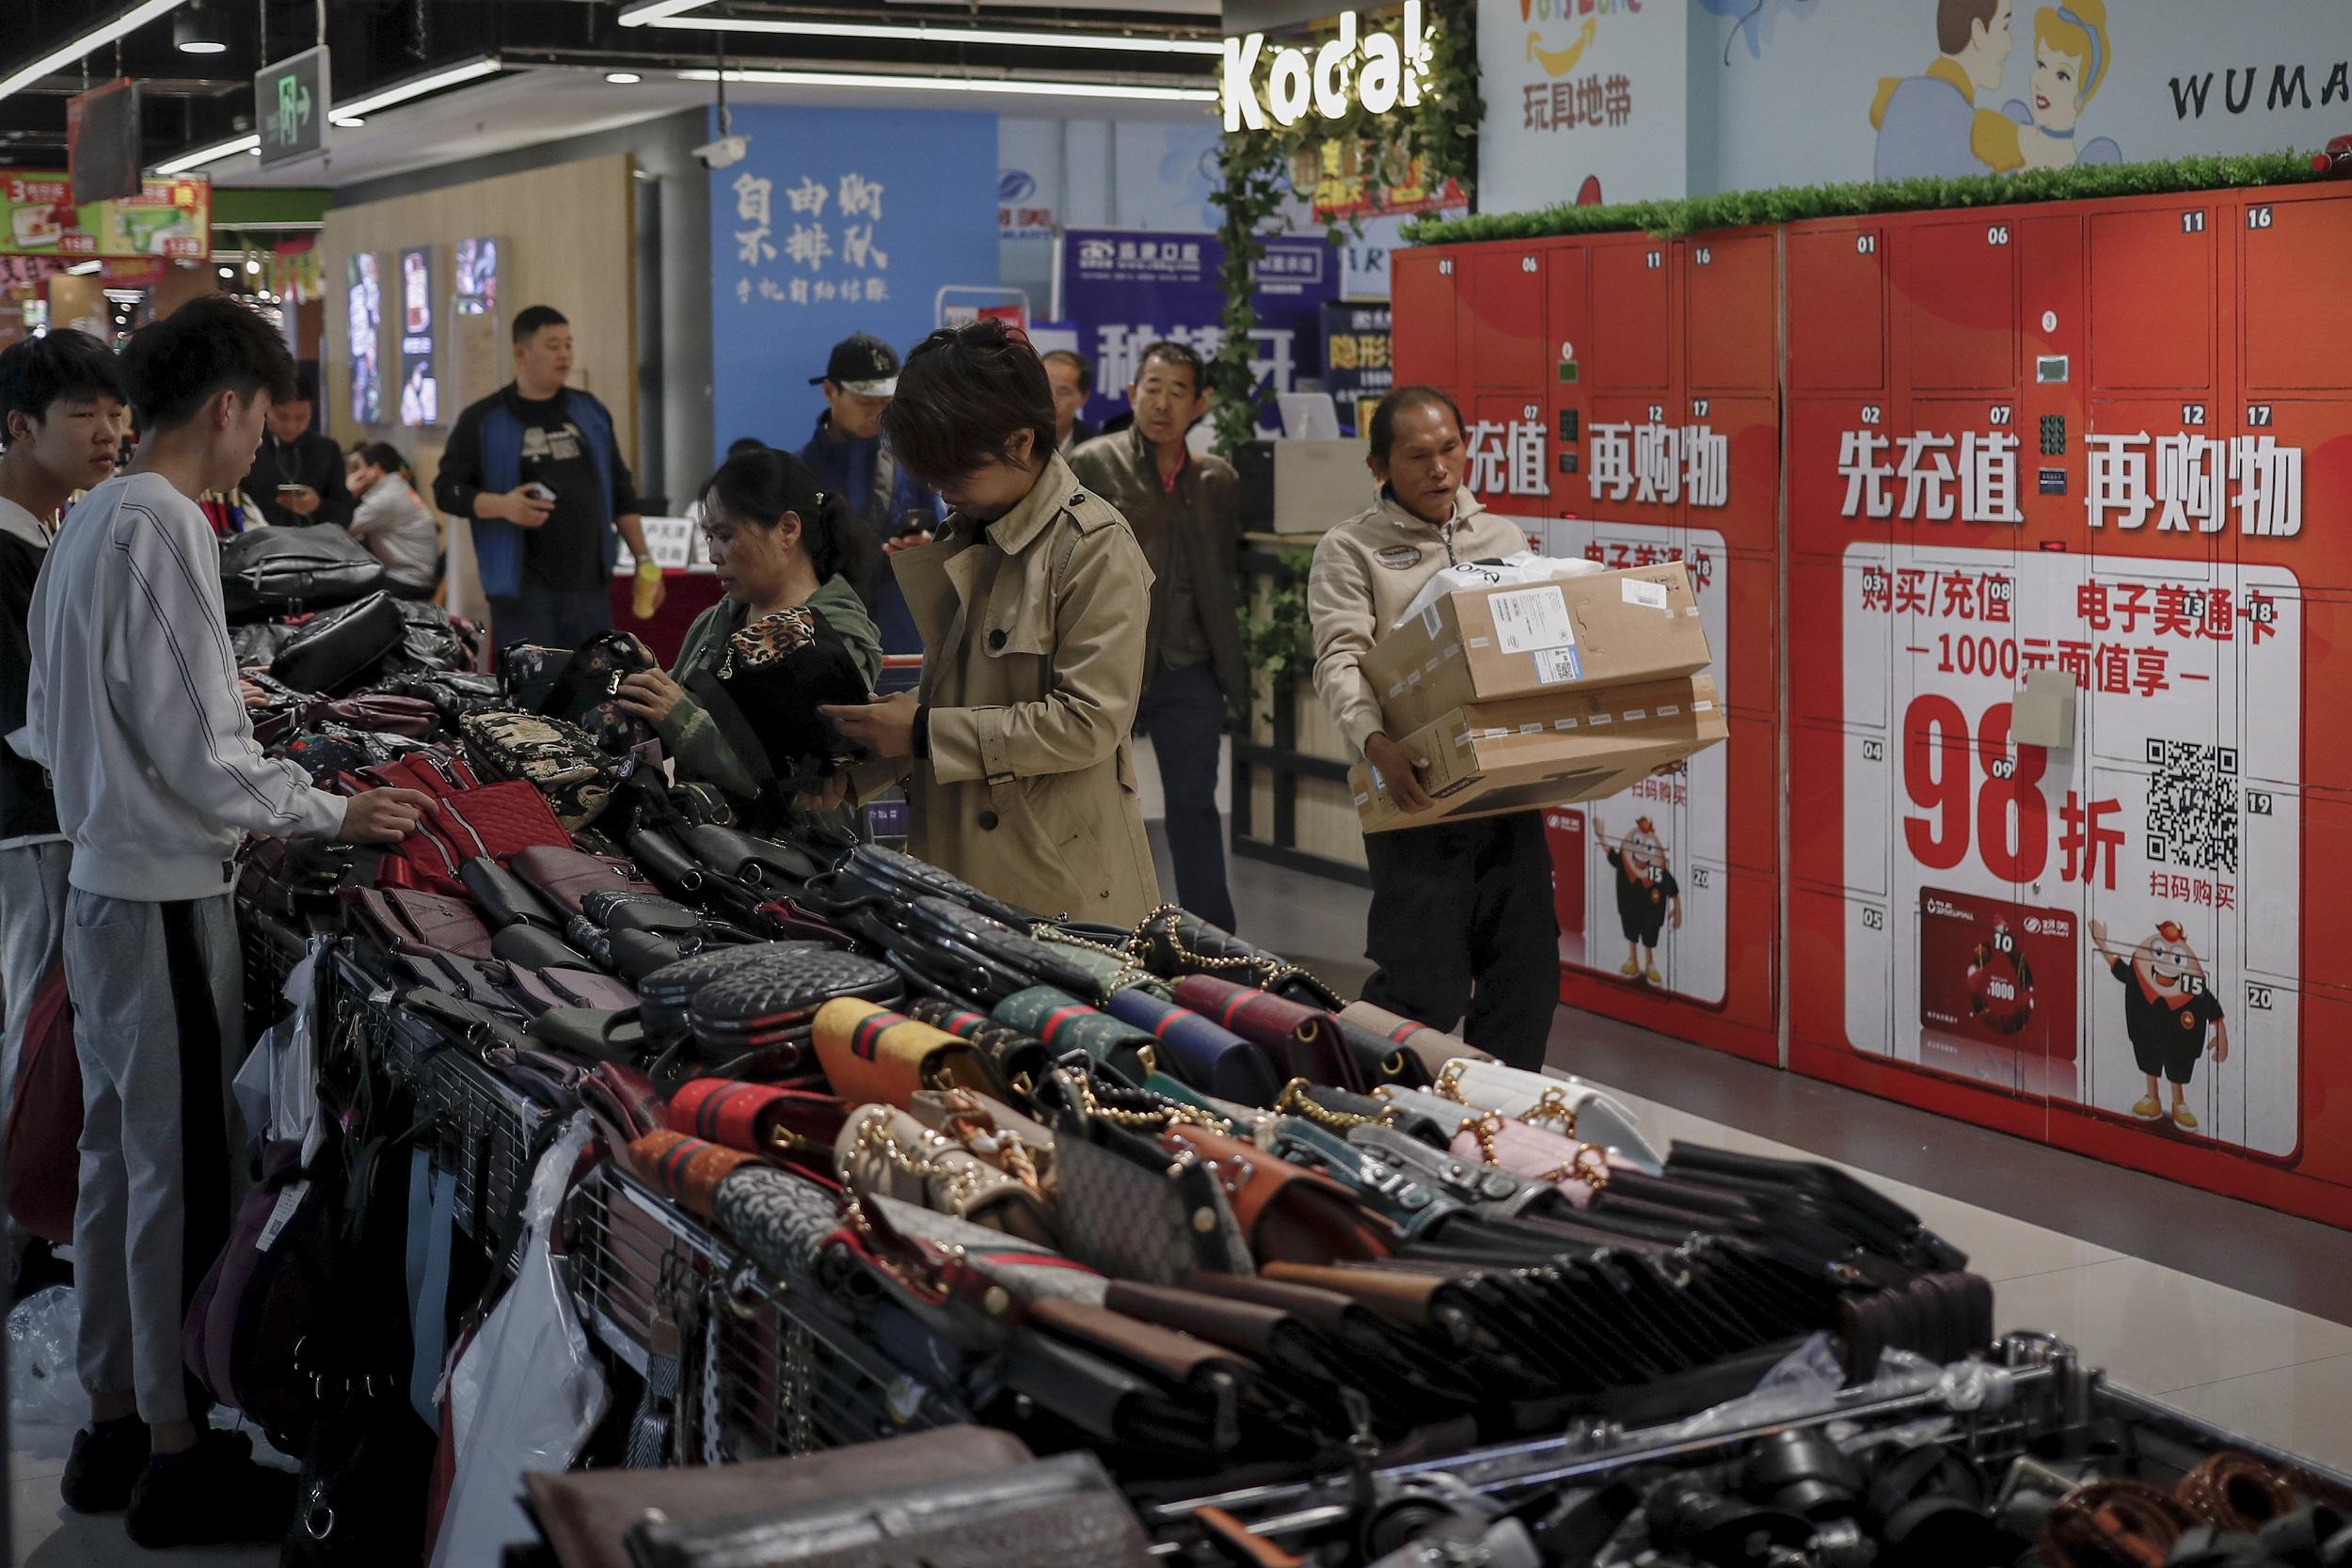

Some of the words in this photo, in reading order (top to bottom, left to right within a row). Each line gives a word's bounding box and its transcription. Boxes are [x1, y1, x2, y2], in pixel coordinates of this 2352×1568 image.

[2169, 61, 2352, 120] WUMA
[1522, 73, 1631, 132] 玩具地带
[732, 174, 885, 226] 自由购
[2182, 212, 2205, 233] 11
[2248, 207, 2272, 230] 16
[1856, 234, 1875, 254] 01
[1987, 226, 2009, 245] 06
[735, 222, 889, 271] 不排队
[1695, 247, 1711, 265] 16
[1438, 260, 1452, 275] 01
[1521, 257, 1537, 273] 06
[1646, 250, 1661, 269] 11
[1523, 405, 1538, 420] 07
[1648, 405, 1662, 421] 12
[1693, 401, 1708, 417] 17
[1861, 405, 1881, 423] 02
[1989, 406, 2011, 424] 07
[2182, 404, 2204, 424] 12
[2248, 405, 2271, 426] 17
[1588, 420, 1728, 508] 再购物
[1837, 429, 2025, 523] 先充值
[2084, 429, 2302, 537] 再购物
[1696, 559, 1711, 578] 18
[1863, 574, 1883, 592] 03
[1990, 583, 2011, 601] 08
[2076, 578, 2279, 645] 电子美通卡
[2182, 595, 2205, 618] 13
[2248, 601, 2272, 623] 18
[1863, 741, 1882, 760] 04
[1992, 759, 2013, 778] 09
[2183, 788, 2204, 809] 14
[2248, 793, 2272, 814] 19
[1648, 865, 1663, 883] 15
[1693, 869, 1708, 888] 20
[2149, 870, 2235, 911] 扫码购买
[1863, 910, 1883, 928] 05
[1994, 932, 2013, 953] 10
[2181, 974, 2203, 995] 15
[2248, 988, 2272, 1010] 20
